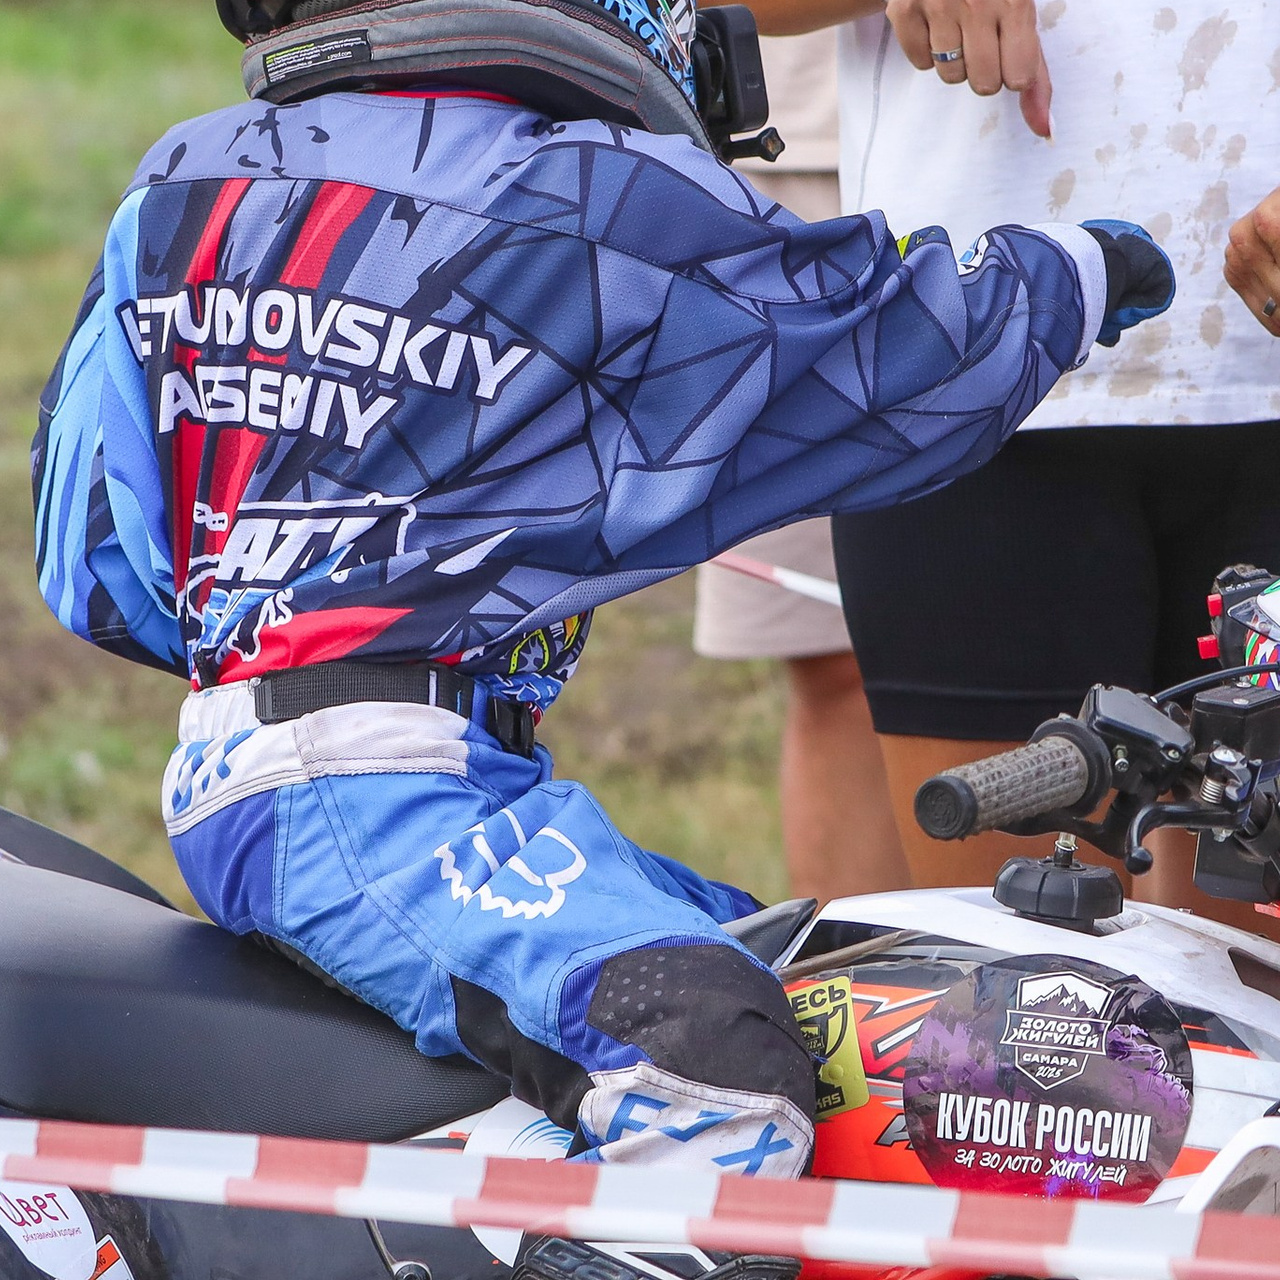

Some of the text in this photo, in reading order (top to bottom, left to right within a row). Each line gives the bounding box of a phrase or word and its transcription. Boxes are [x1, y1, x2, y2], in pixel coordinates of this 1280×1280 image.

[791, 984, 847, 1014] ЕСЬ
[1020, 1017, 1092, 1035] ЗОЛОТО
[1006, 1028, 1099, 1048] ЖИГУЛЕЙ
[1022, 1053, 1078, 1067] САМАРА
[1035, 1066, 1063, 1079] 2025
[936, 1092, 1030, 1149] КУБОК
[1035, 1103, 1152, 1162] РОССИИ
[954, 1149, 1128, 1186] ЗА ЗОЛОТО ЖИГУЛЕЙ
